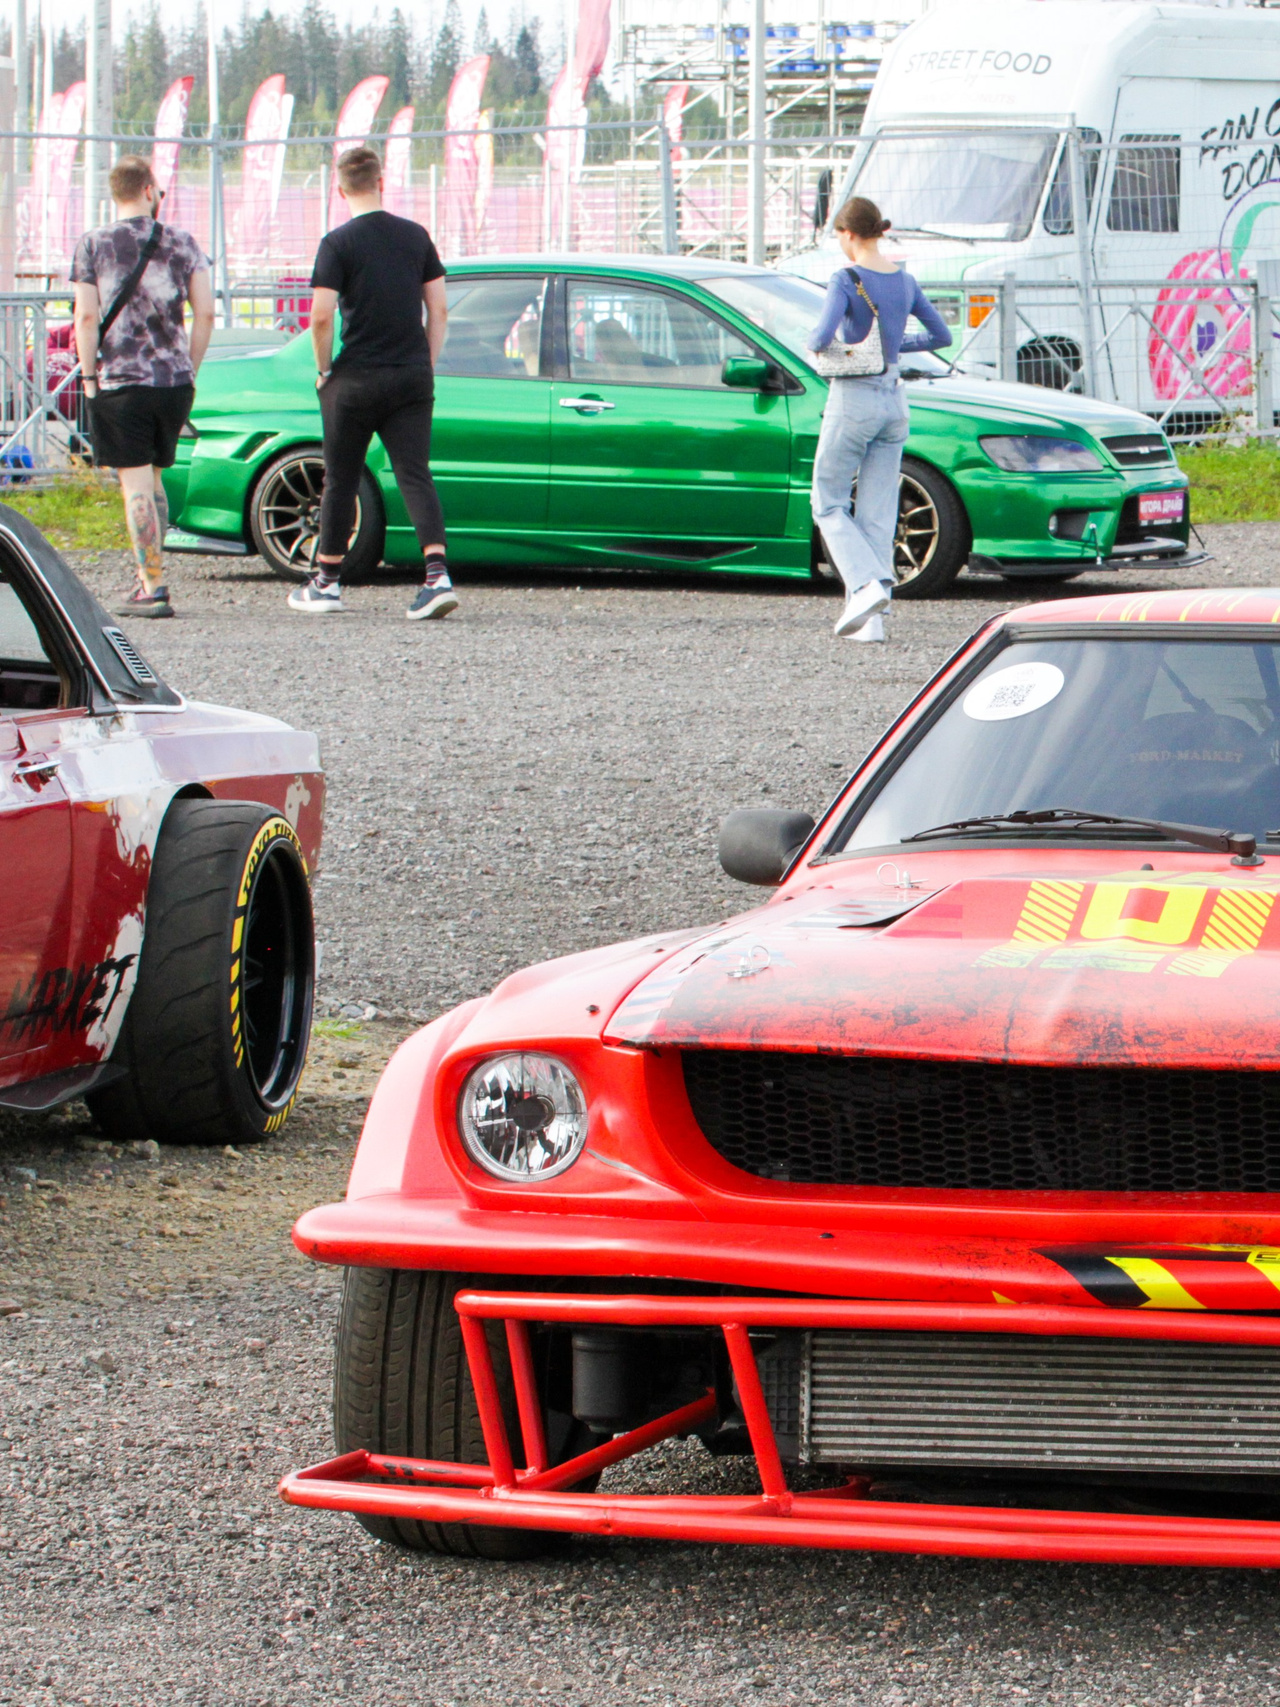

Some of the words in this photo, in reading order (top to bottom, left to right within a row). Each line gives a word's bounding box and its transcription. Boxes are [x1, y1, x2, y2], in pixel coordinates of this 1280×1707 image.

[905, 50, 978, 73] STREET
[979, 50, 1052, 75] FOOD
[1199, 106, 1260, 168] FAN
